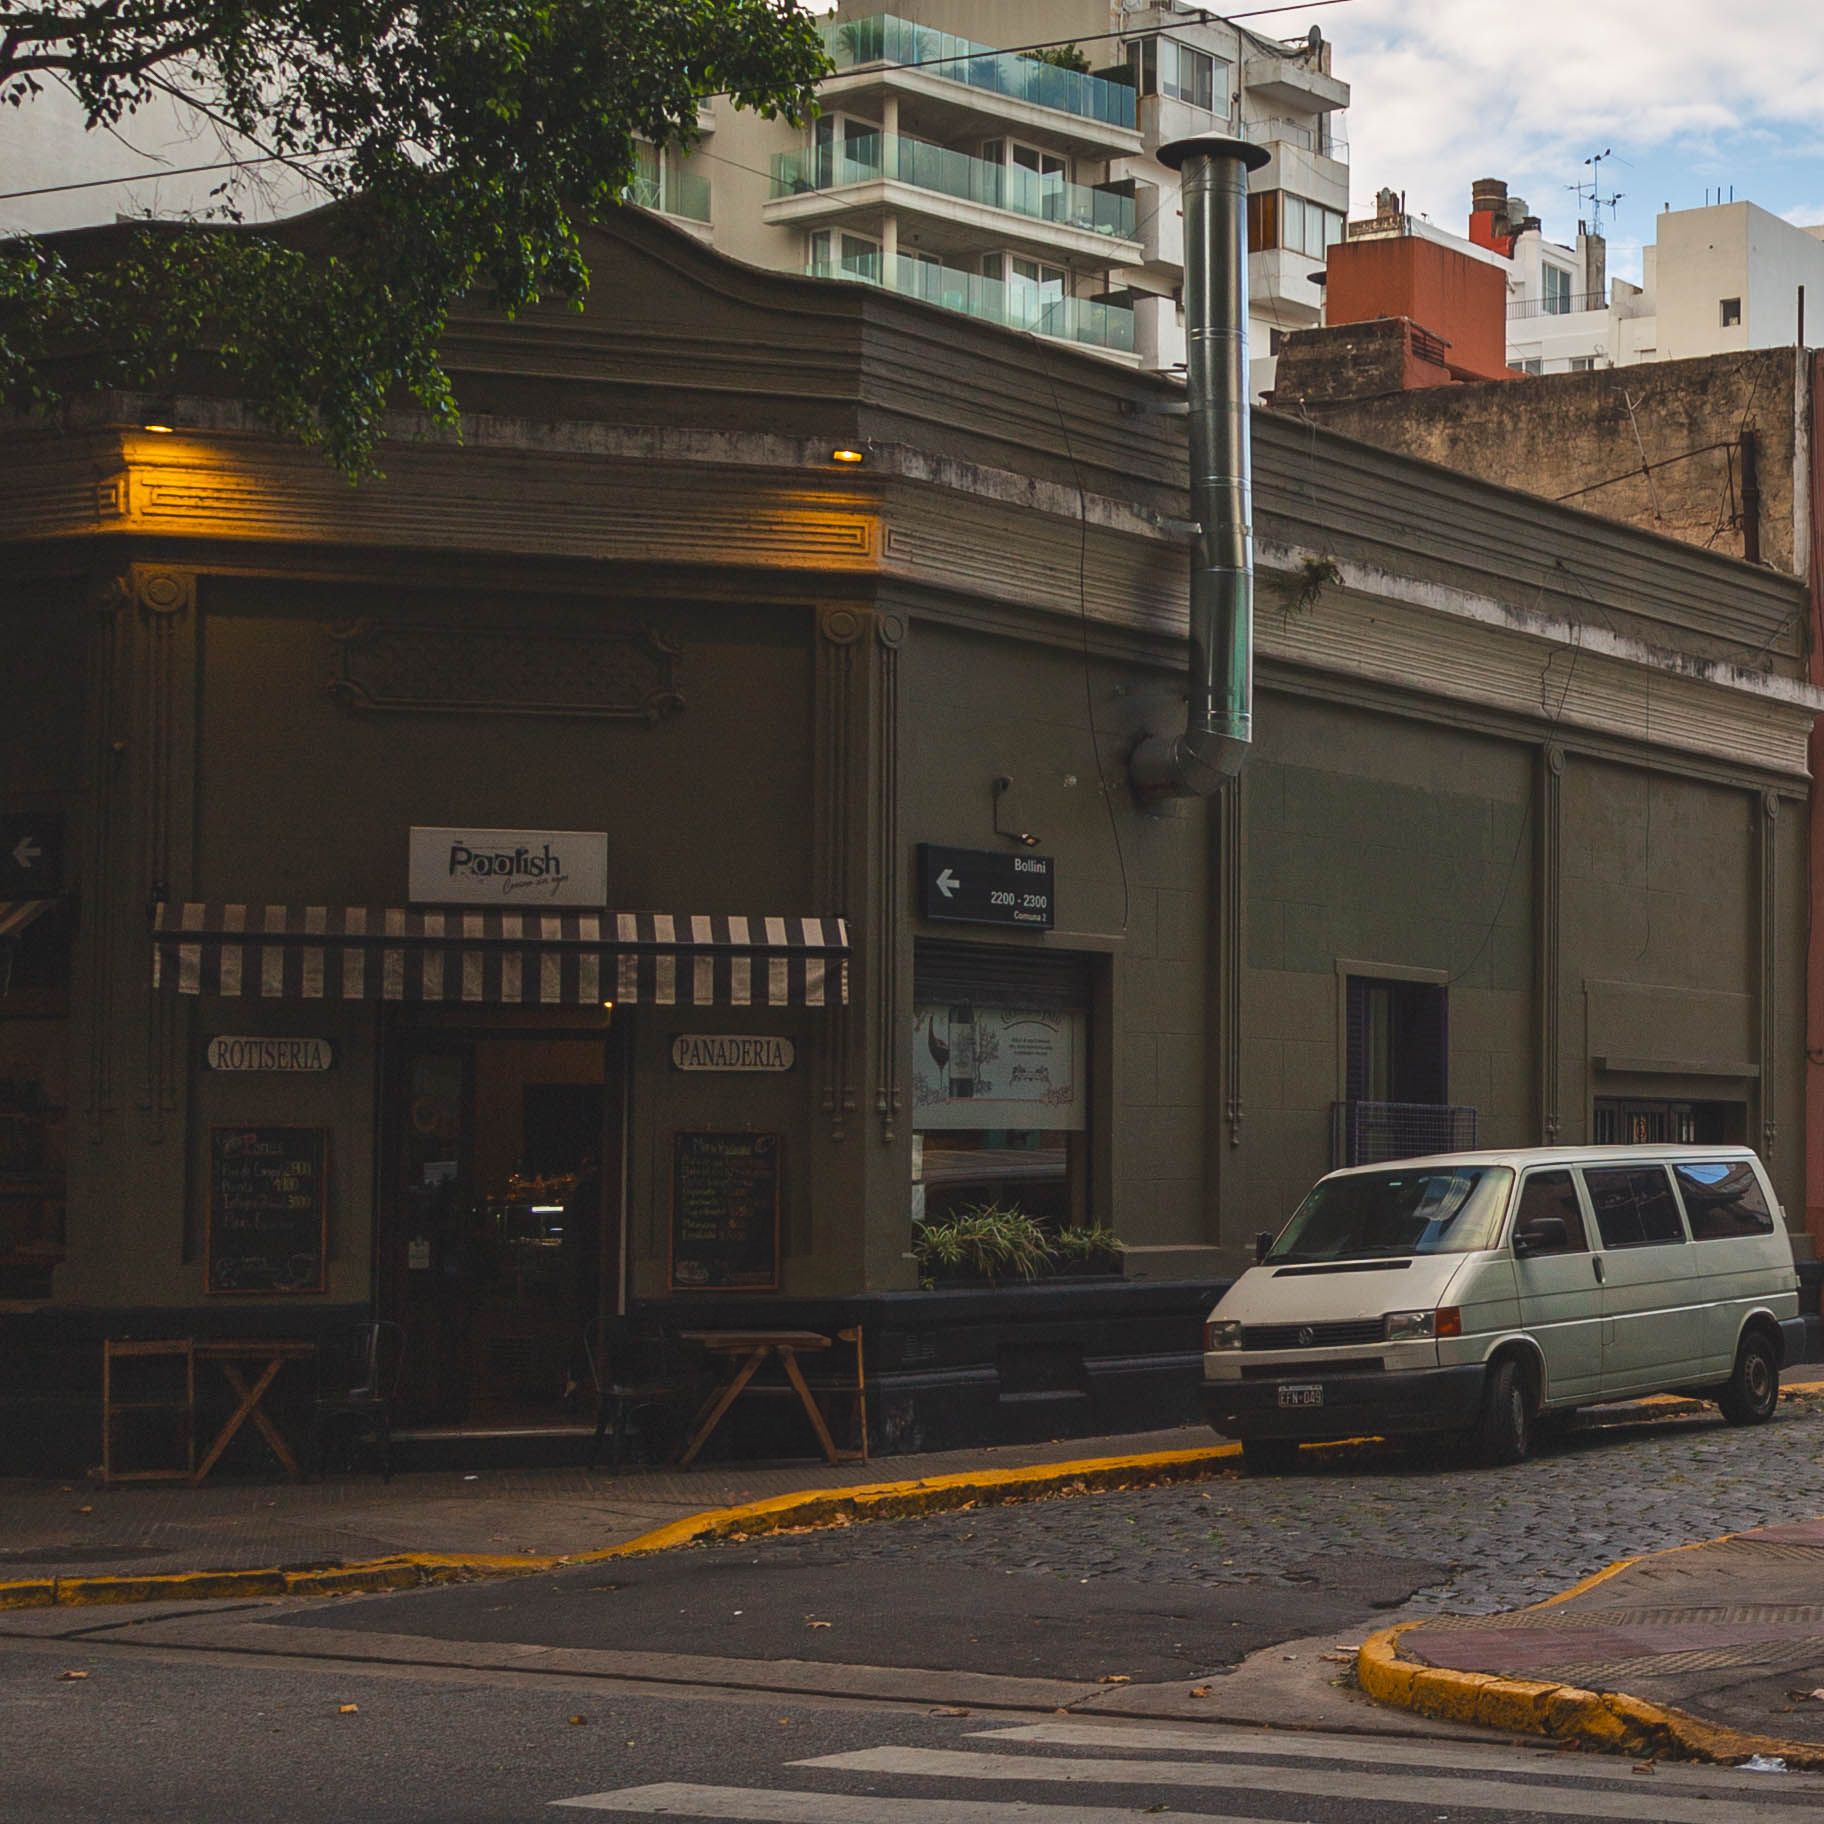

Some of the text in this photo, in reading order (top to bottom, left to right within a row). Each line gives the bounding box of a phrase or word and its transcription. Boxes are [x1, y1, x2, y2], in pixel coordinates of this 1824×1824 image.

[449, 843, 561, 877] Poolish
[1014, 858, 1046, 874] Bollini
[991, 891, 1015, 907] 2200
[1023, 894, 1047, 909] 2300
[217, 1040, 322, 1068] ROTISERIA
[679, 1039, 785, 1067] PANADERIA
